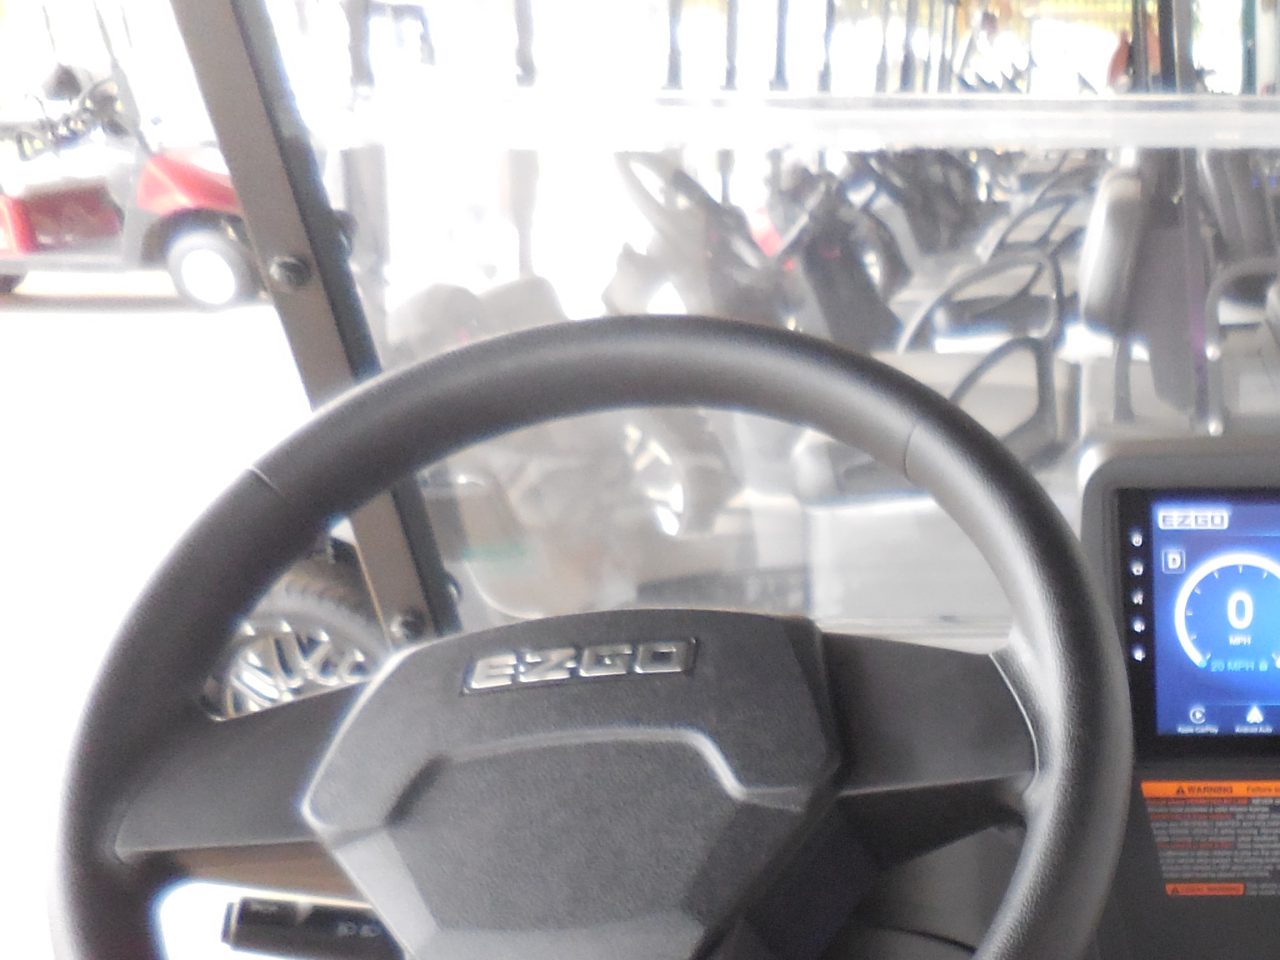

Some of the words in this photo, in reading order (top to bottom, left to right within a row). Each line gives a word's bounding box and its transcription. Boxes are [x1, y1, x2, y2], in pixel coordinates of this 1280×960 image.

[1161, 514, 1225, 528] EZGO
[1168, 552, 1181, 569] D
[1228, 592, 1253, 629] 0
[1229, 635, 1251, 646] MPH
[471, 641, 689, 690] EZGO
[1227, 661, 1254, 672] MPH
[1187, 786, 1233, 794] WARNING
